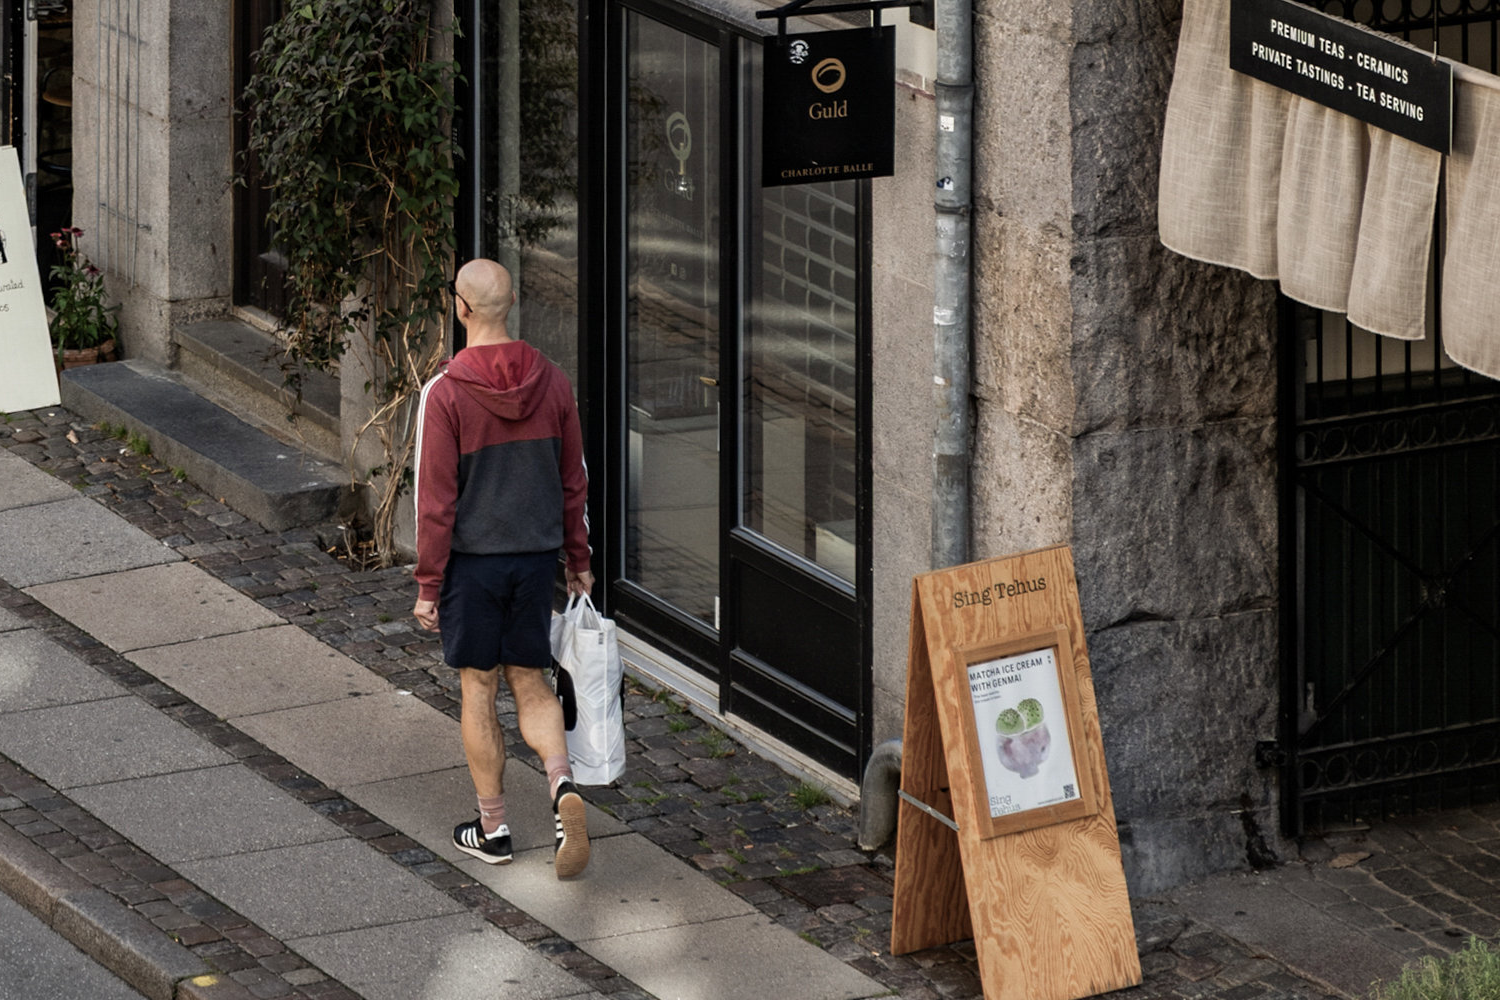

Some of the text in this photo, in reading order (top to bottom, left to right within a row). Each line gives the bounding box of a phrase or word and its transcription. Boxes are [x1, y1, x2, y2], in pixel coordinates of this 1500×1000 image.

[1270, 18, 1315, 48] PREMIUM
[1319, 37, 1345, 60] TEAS
[1356, 52, 1408, 85] CERAMICS
[1252, 41, 1292, 70] PRIVATE
[1296, 58, 1344, 91] TASTINGS
[1356, 82, 1376, 104] TEA
[1380, 91, 1424, 121] SERVING
[809, 100, 848, 120] Guld
[781, 163, 874, 178] CHARLOTTE BALLE
[953, 577, 1047, 608] Sing Tehus
[969, 658, 1043, 681] MATCHA ICE CREAM
[971, 674, 1022, 692] WITH GENMAI
